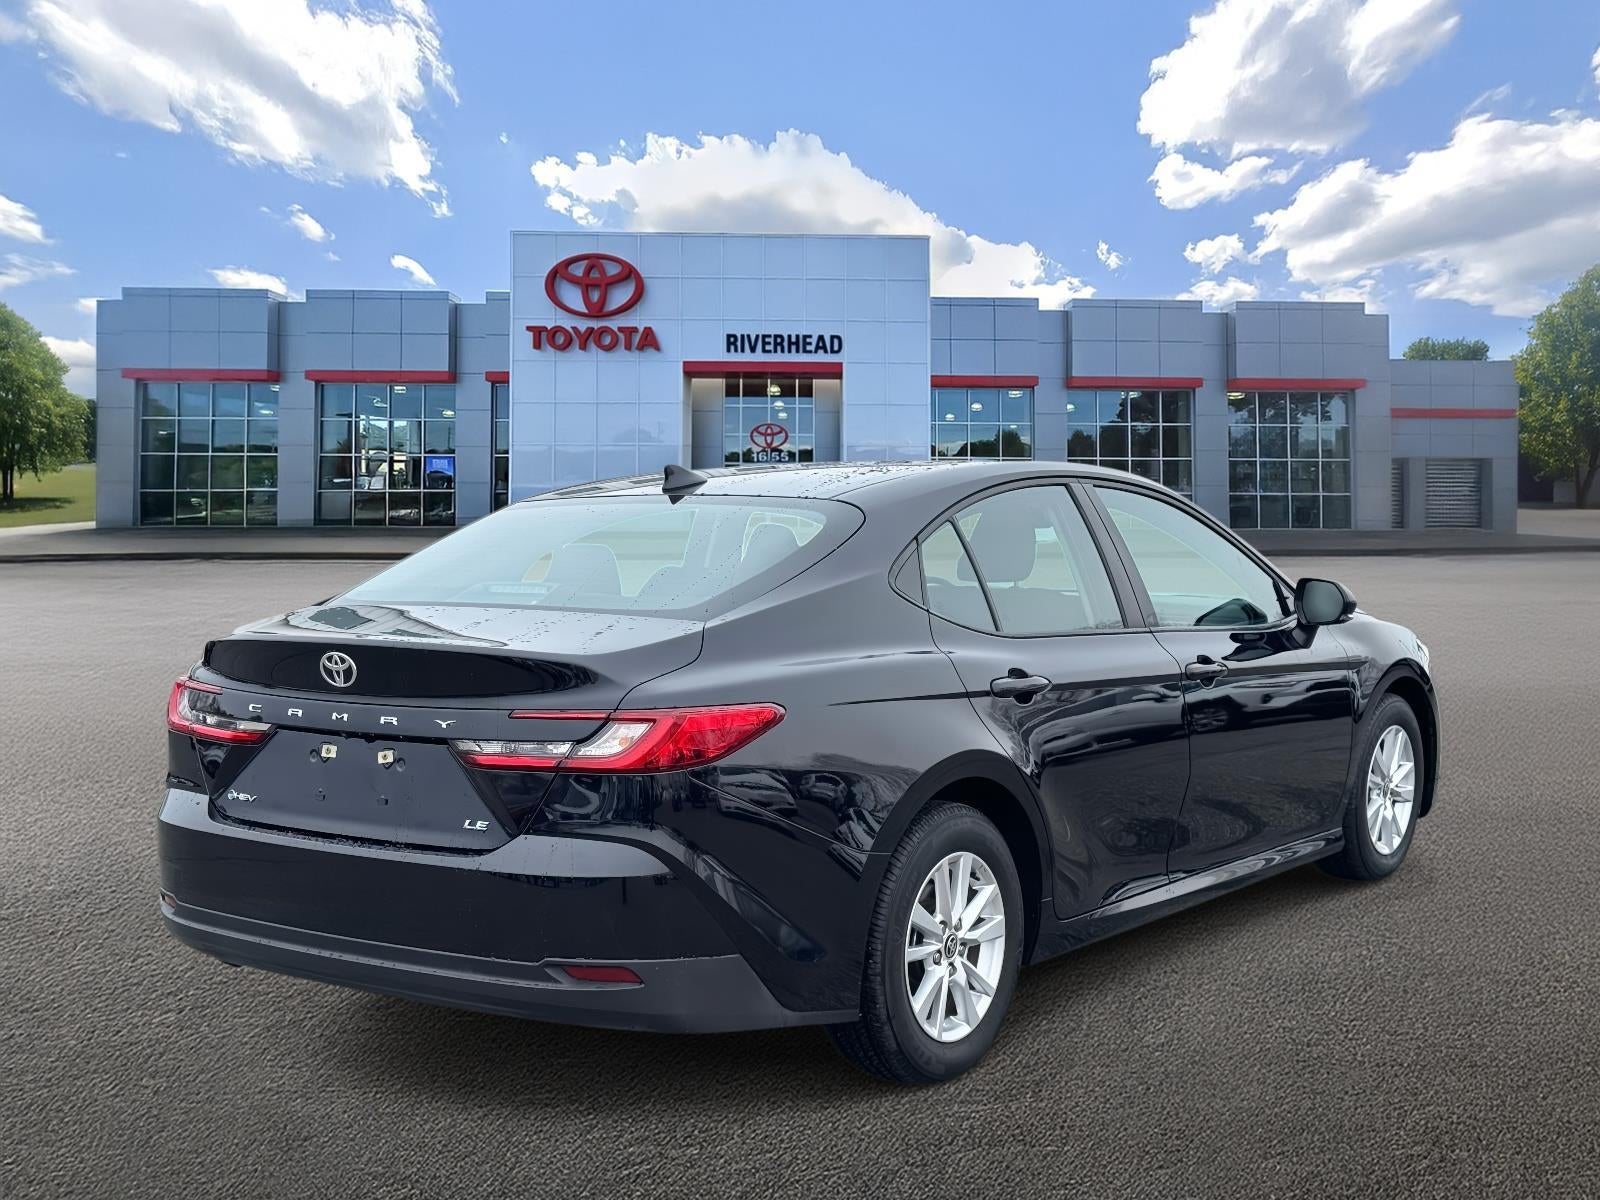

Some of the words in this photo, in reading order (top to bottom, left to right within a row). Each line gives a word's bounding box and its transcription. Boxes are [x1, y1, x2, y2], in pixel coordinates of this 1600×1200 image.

[526, 325, 661, 352] TOYOTA
[725, 334, 843, 354] RIVERHEAD
[248, 703, 456, 729] CAMRY
[463, 819, 490, 832] LE
